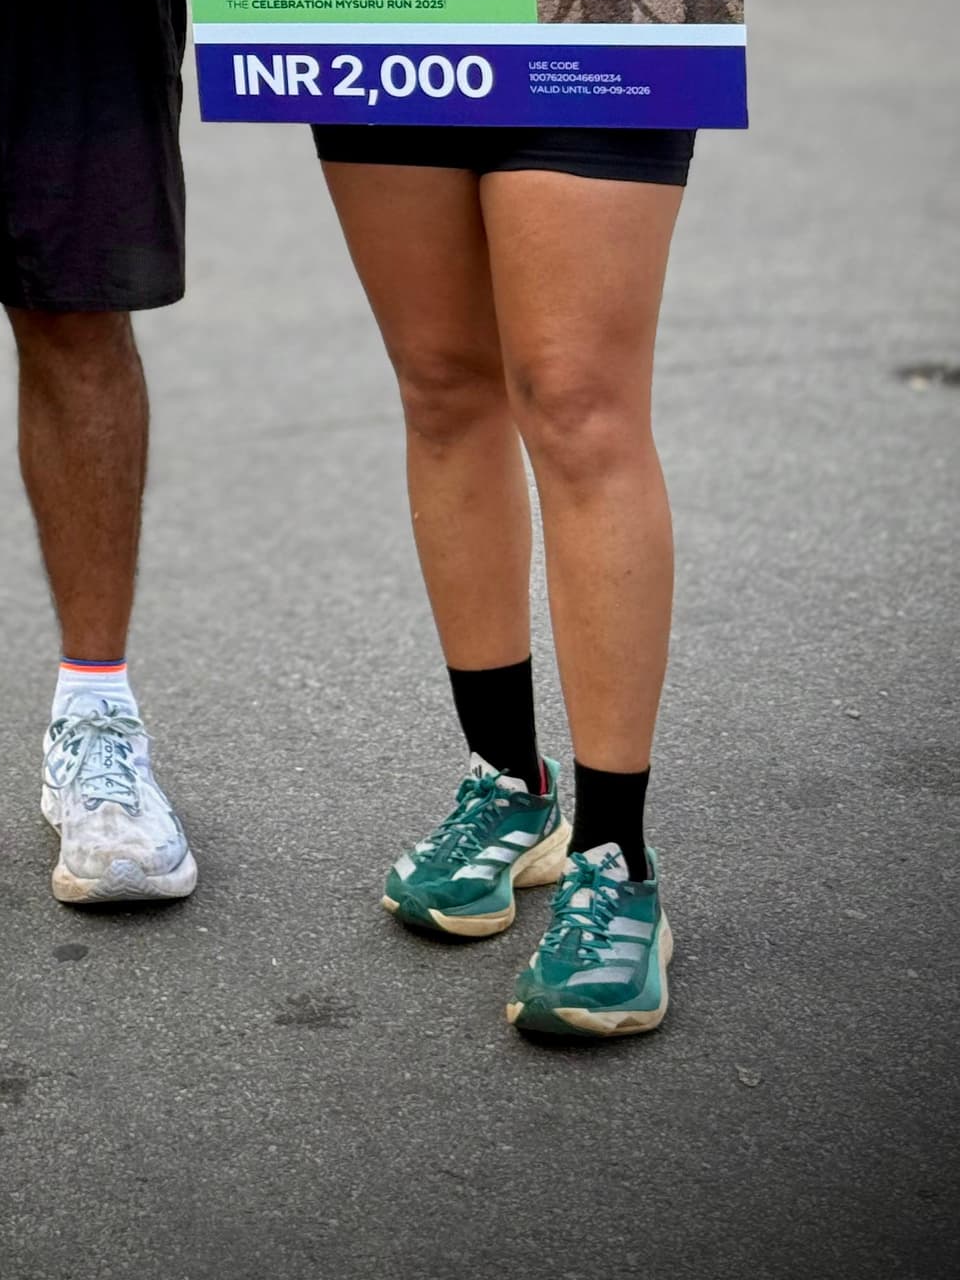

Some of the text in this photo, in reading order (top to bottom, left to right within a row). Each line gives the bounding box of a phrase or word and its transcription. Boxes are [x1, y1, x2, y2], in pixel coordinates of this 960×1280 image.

[227, 0, 248, 9] THE
[251, 0, 332, 9] CELEBRATION
[336, 0, 384, 9] MYSURU
[387, 0, 412, 8] RUN
[528, 61, 580, 70] USE CODE
[233, 54, 493, 106] INR 2,000
[530, 85, 650, 95] VALID UNTIL 09-09-2026
